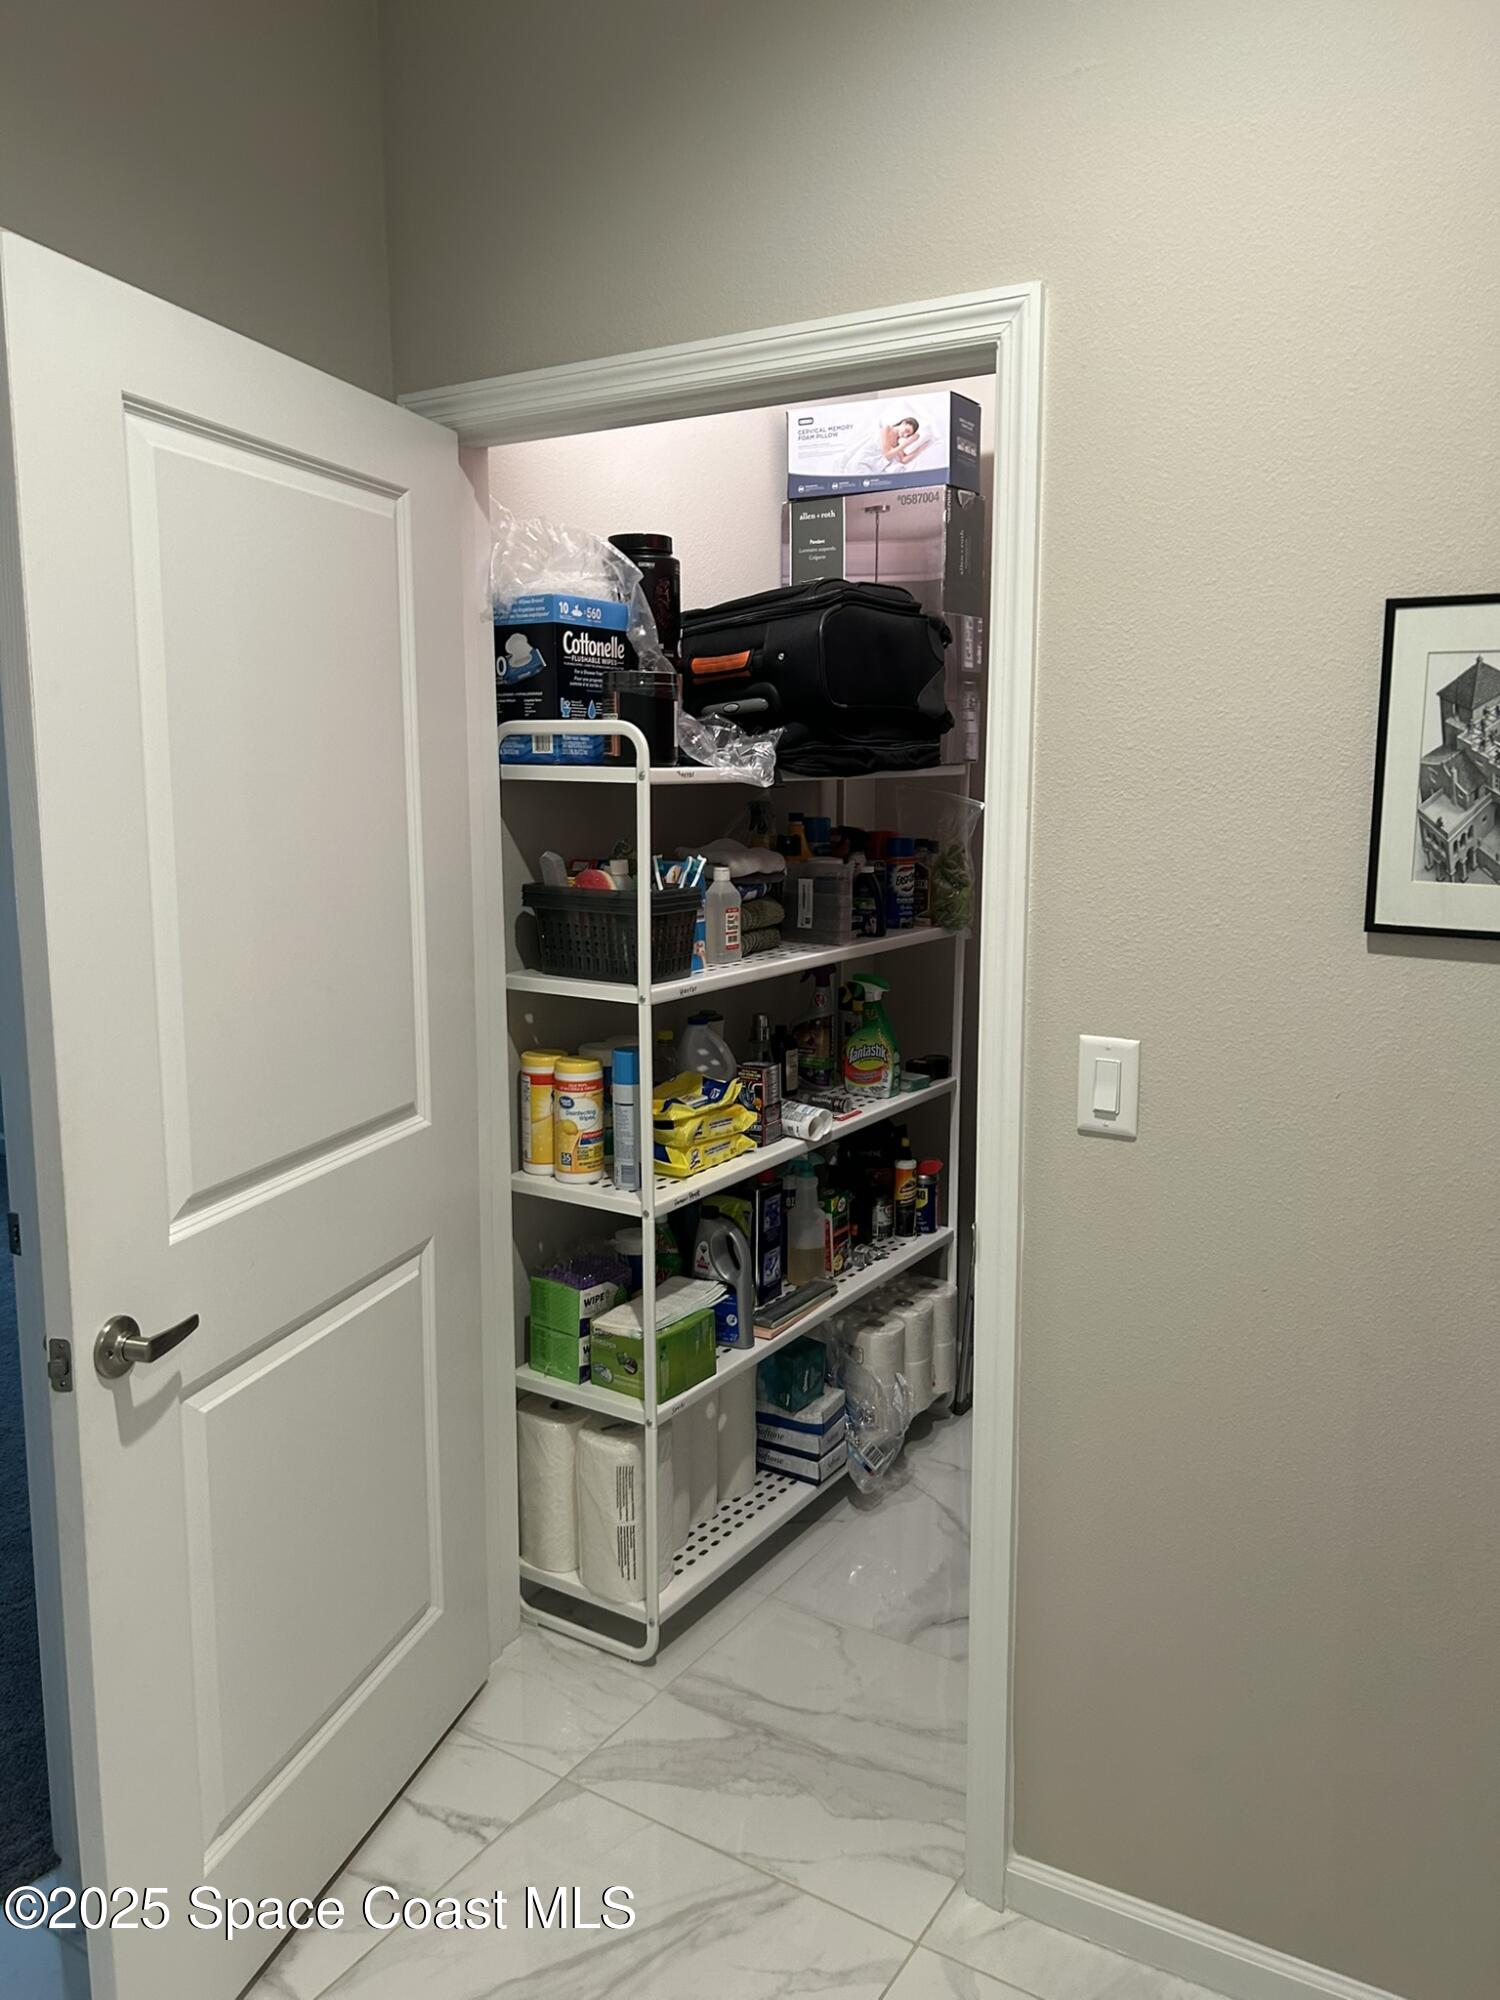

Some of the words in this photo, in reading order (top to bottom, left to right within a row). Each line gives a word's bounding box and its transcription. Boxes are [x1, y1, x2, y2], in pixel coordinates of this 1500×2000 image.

[797, 427, 827, 436] CERVICAL
[828, 424, 854, 432] MEMORY
[816, 432, 839, 440] PILLOW
[799, 512, 816, 521] allen
[821, 510, 836, 519] roth
[558, 601, 569, 614] 10
[586, 606, 602, 620] 560
[562, 630, 625, 660] Cottonelle
[571, 655, 601, 665] FLUSHABLE
[601, 658, 618, 666] WIPES
